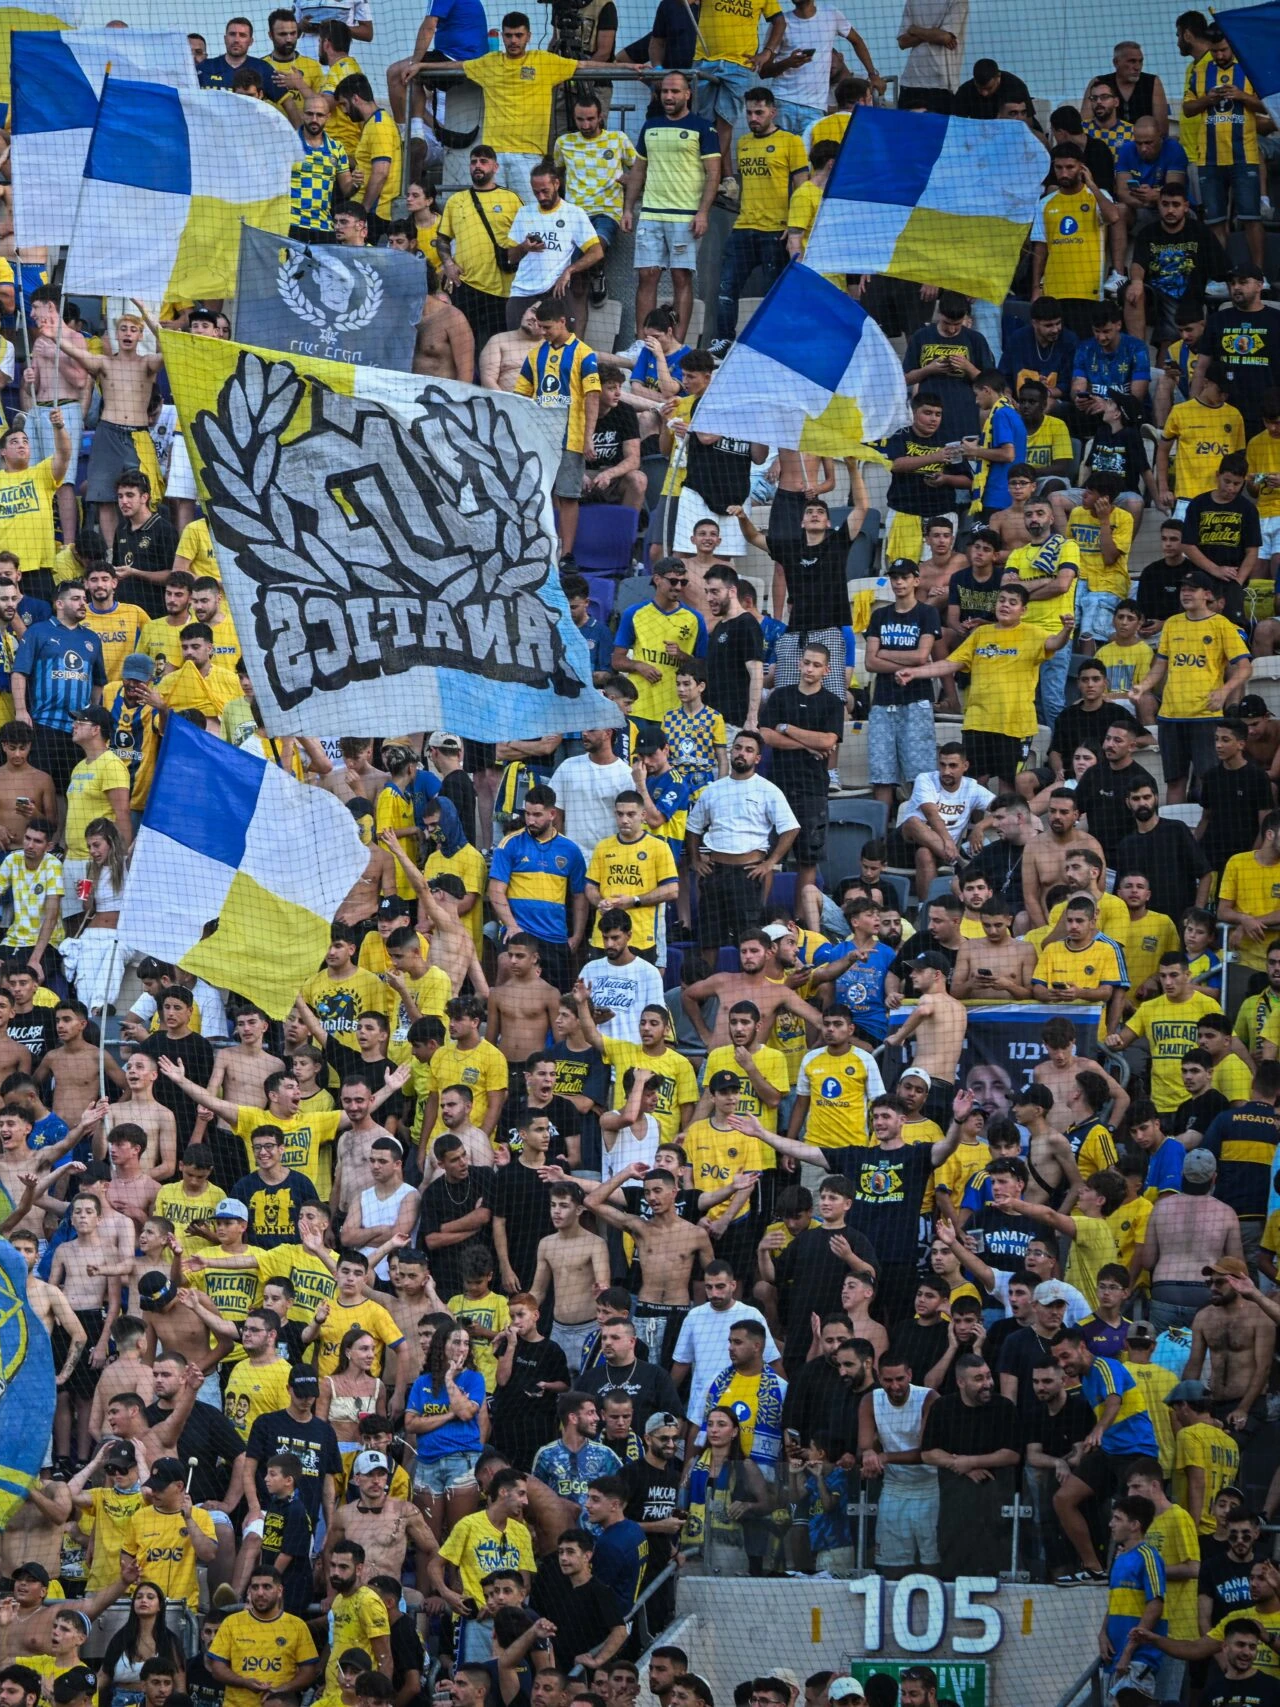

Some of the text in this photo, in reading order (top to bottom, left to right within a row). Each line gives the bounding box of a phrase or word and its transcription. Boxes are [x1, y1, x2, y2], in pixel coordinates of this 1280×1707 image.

[714, 2, 754, 19] CANADA
[740, 157, 766, 167] ISRAEL
[880, 624, 920, 638] ANATICS
[894, 636, 917, 647] TOUR
[609, 864, 641, 876] ISRAEL
[607, 875, 644, 888] CANADA
[596, 976, 637, 991] Maccabi
[282, 1130, 309, 1150] CABI
[280, 1150, 304, 1165] ATICS
[984, 1230, 1035, 1244] FANATI
[990, 1243, 1005, 1254] ON
[206, 1276, 255, 1299] MACCABI
[292, 1276, 335, 1300] MACCABI
[423, 1403, 449, 1414] ISRA
[647, 1486, 676, 1502] MACCAB
[145, 1546, 184, 1562] 1906
[1216, 1576, 1250, 1595] FANA
[1223, 1591, 1239, 1603] ON
[850, 1573, 1004, 1654] 105
[241, 1655, 283, 1672] 1906
